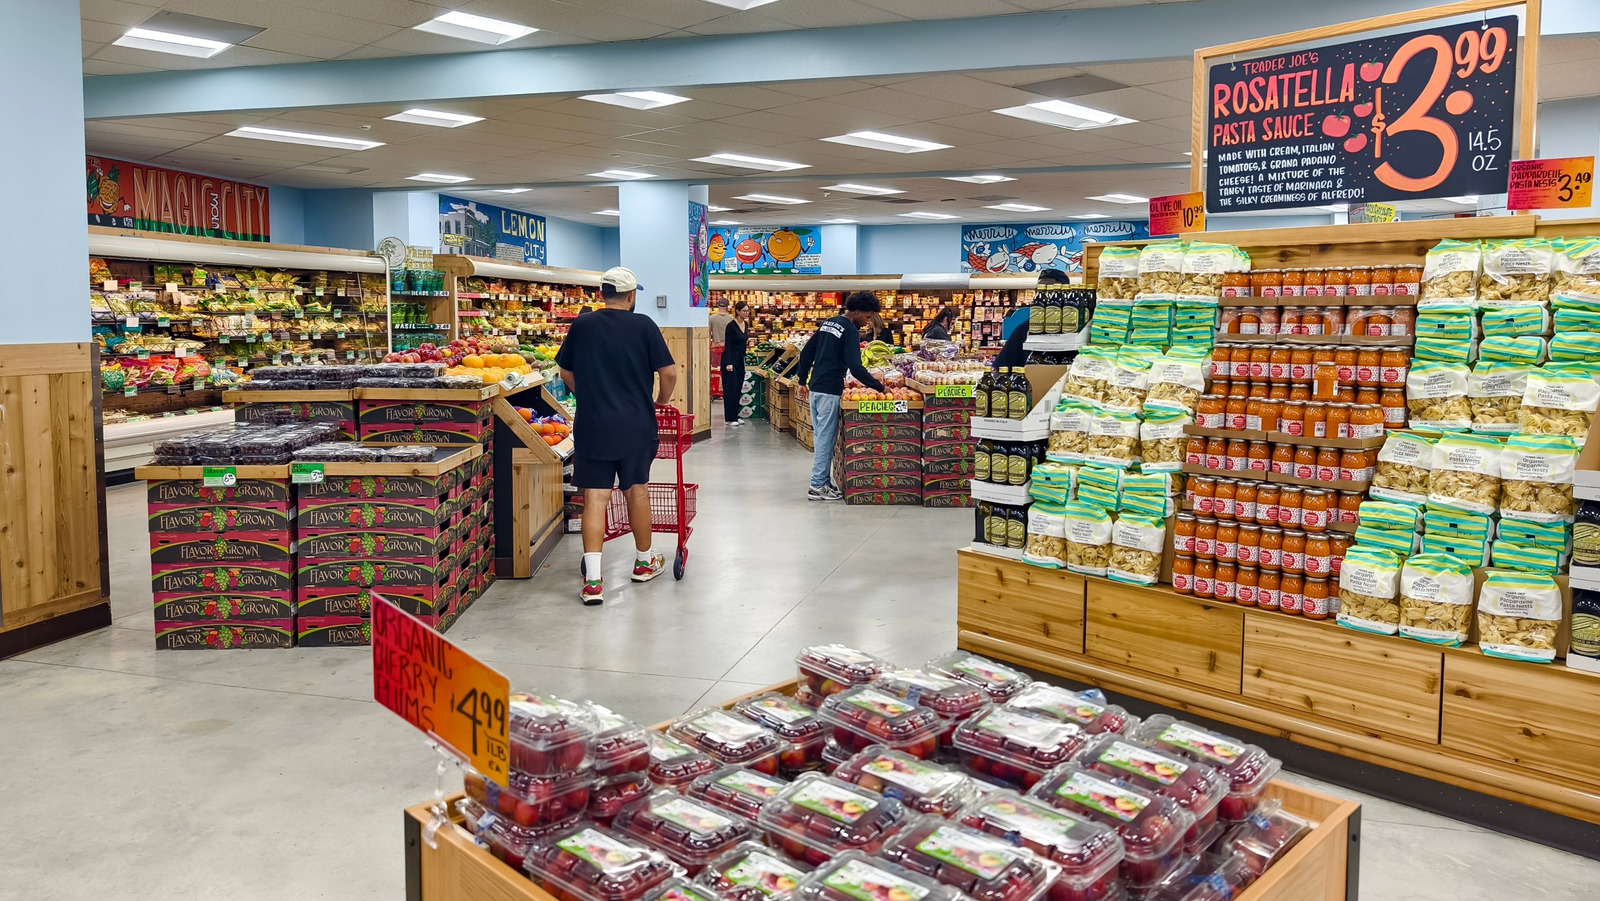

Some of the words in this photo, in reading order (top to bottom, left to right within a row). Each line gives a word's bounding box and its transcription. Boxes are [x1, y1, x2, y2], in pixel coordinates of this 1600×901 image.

[1242, 58, 1285, 76] TRADER
[1289, 52, 1318, 68] JOE'S
[1214, 63, 1354, 119] ROSATELLA
[1213, 120, 1256, 147] PASTA
[1262, 112, 1314, 141] SAUCE
[1469, 130, 1502, 151] 14.5
[1218, 151, 1242, 162] MADE
[1245, 149, 1267, 160] WITH
[1270, 146, 1300, 156] CREAM,
[1302, 143, 1334, 154] ITALIAN
[1270, 159, 1298, 170] GRANA
[1302, 155, 1336, 166] PADANO
[1472, 154, 1498, 171] OZ
[1512, 164, 1544, 172] ORGANIC
[1219, 174, 1254, 186] CHEESE!
[1258, 174, 1264, 182] A
[1268, 170, 1309, 181] MIXTURE
[1312, 168, 1324, 176] OF
[1328, 167, 1345, 176] THE
[1510, 180, 1532, 189] PASTA
[1534, 179, 1556, 187] NESTS
[1219, 187, 1245, 196] TANGY
[1248, 184, 1272, 194] TASTE
[1274, 182, 1284, 192] OF
[1286, 180, 1333, 190] MARINARA
[1336, 178, 1343, 188] &
[133, 167, 214, 238] MAGIC
[220, 181, 266, 242] CITY
[1219, 198, 1232, 207] THE
[1236, 196, 1258, 205] SILKY
[1261, 193, 1306, 204] CREAMINESS
[1308, 192, 1319, 201] OF
[1322, 188, 1365, 200] ALFREDO!
[1150, 201, 1172, 212] OLIVE
[1174, 200, 1182, 211] OIL
[501, 210, 545, 242] LEMON
[524, 242, 544, 260] CITY
[312, 407, 343, 418] GROWN
[386, 409, 414, 420] FLAVOR
[424, 408, 452, 418] GROWN
[160, 485, 194, 499] FLAVOR
[238, 485, 275, 498] GROWN
[310, 481, 344, 495] FLAVOR
[387, 480, 422, 494] GROWN
[160, 515, 194, 529] FLAVOR
[239, 515, 276, 527] GROWN
[310, 510, 344, 525] FLAVOR
[387, 510, 422, 524] GROWN
[182, 546, 213, 559] FLAVOR
[226, 545, 260, 557] GROWN
[310, 540, 344, 554] FLAVOR
[386, 540, 422, 552] GROWN
[164, 576, 197, 590] FLAVOR
[241, 575, 277, 587] GROWN
[310, 569, 343, 583] FLAVOR
[386, 569, 422, 581] GROWN
[166, 604, 199, 618] FLAVOR
[243, 603, 279, 615] GROWN
[326, 599, 357, 612] FLAVOR
[168, 633, 201, 648] FLAVOR
[244, 633, 280, 645] GROWN
[328, 630, 359, 643] FLAVOR
[374, 600, 452, 680] ORGANIC
[374, 638, 438, 704] CHERRY
[376, 672, 435, 732] PLUMS
[488, 760, 502, 773] EA
